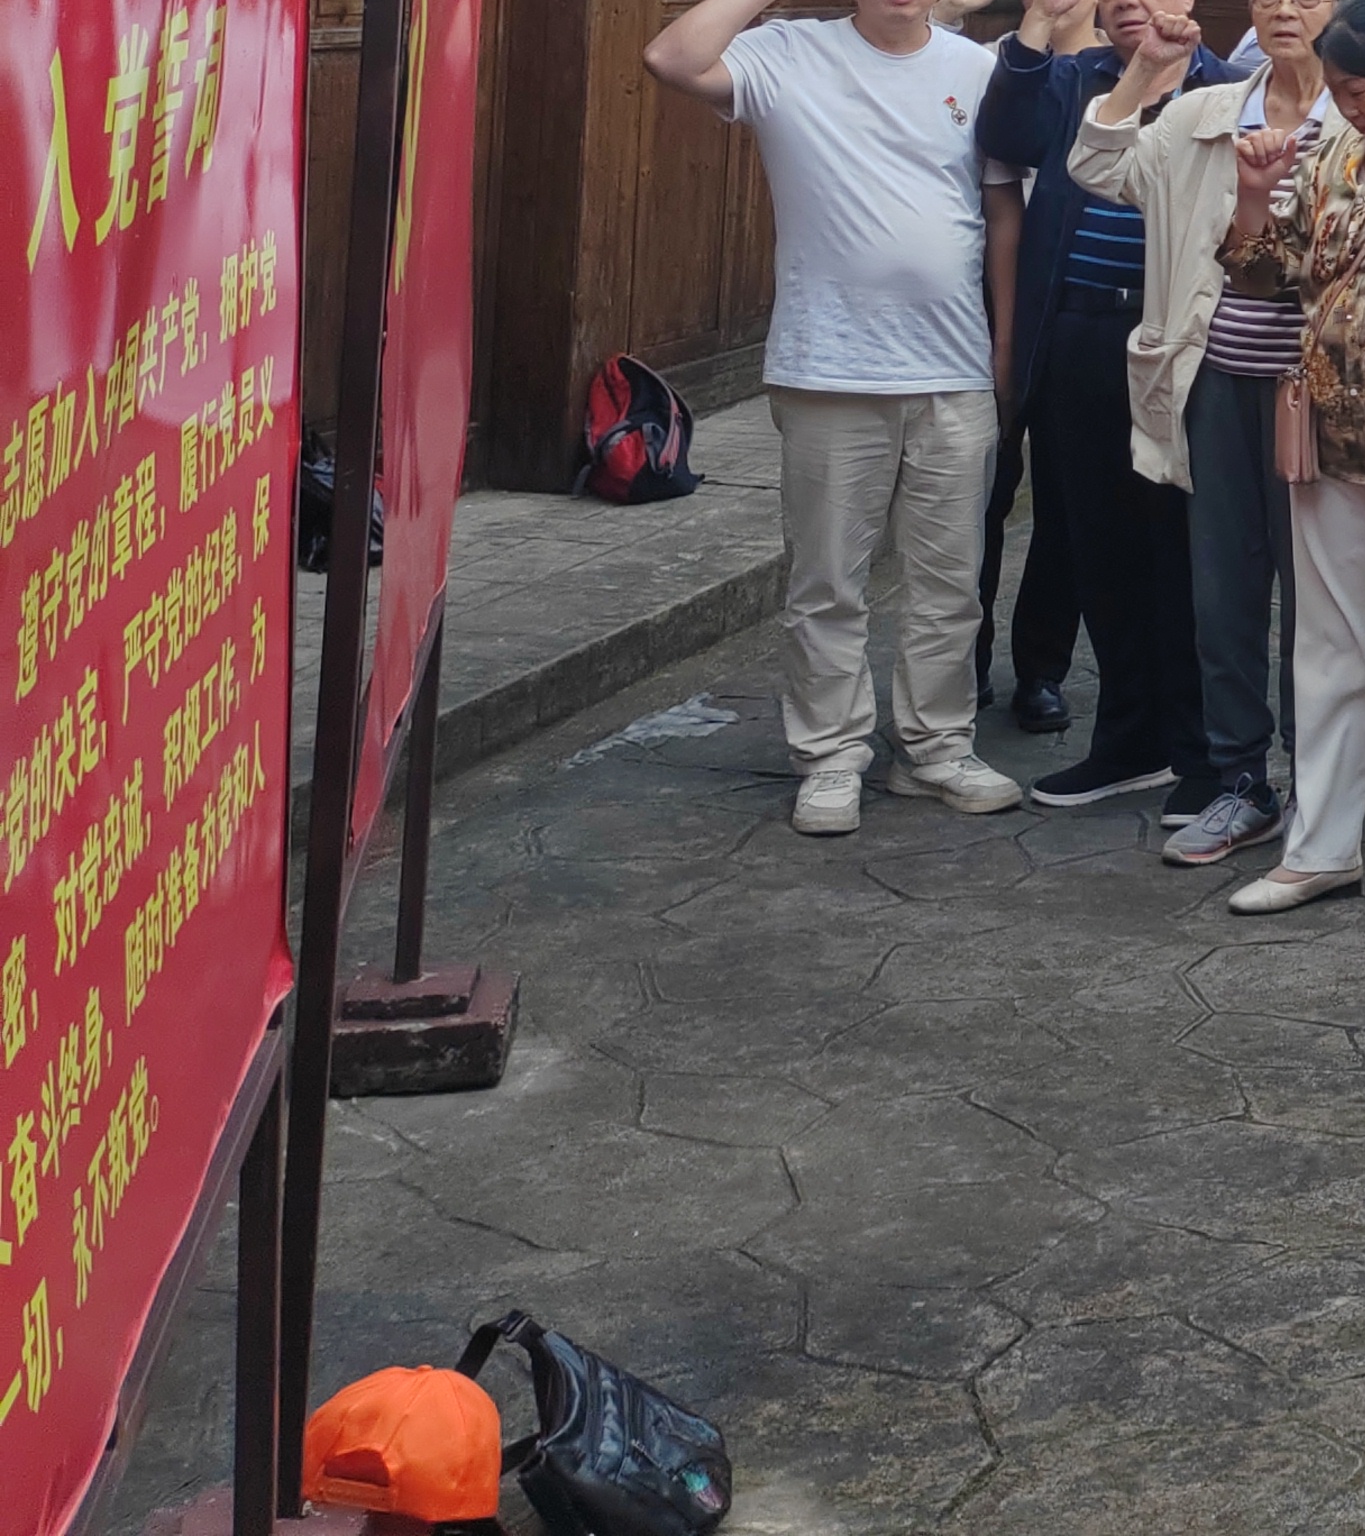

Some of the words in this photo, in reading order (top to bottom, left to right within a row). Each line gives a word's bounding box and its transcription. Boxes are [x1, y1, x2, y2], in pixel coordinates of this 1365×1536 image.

[0, 473, 271, 895] 党的决定，严守党的纪律，保
[0, 719, 266, 1265] 奋斗终身，随时准备为党和人
